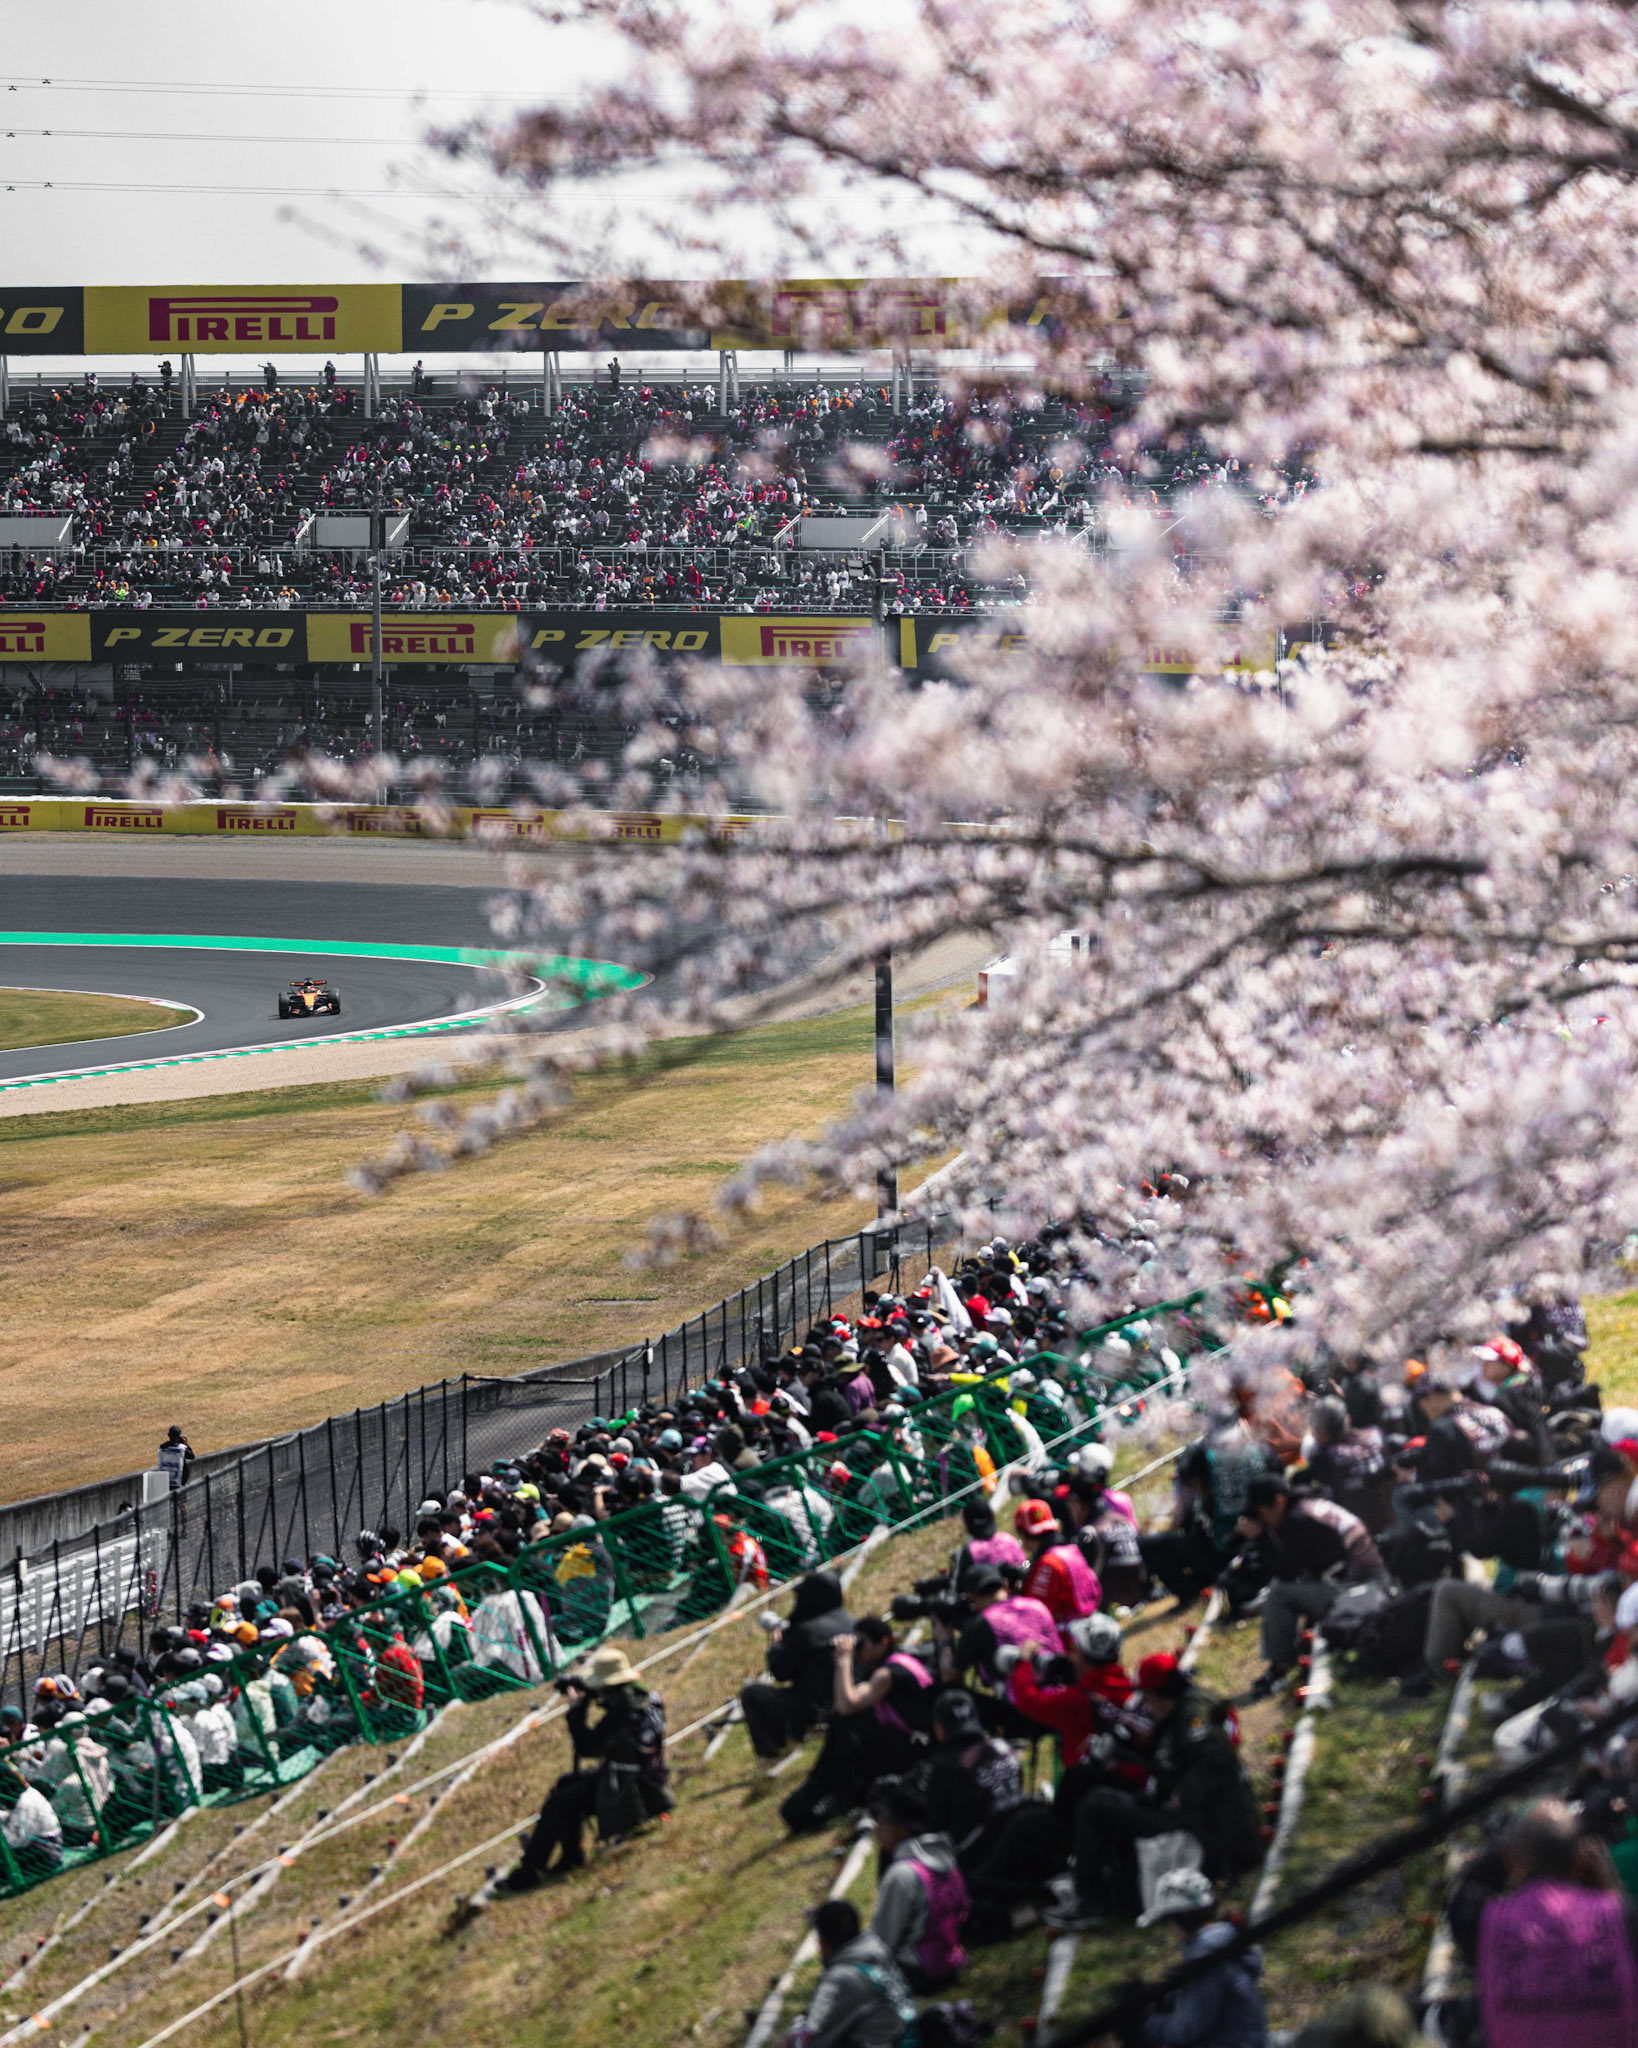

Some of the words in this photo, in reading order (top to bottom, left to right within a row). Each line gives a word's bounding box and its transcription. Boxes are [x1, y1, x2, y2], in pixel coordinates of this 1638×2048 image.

[0, 307, 64, 334] O
[148, 296, 338, 341] PIRELLI
[421, 303, 475, 331] P
[0, 622, 46, 652] LLI
[104, 628, 142, 647] P
[151, 628, 294, 647] ZERO
[532, 630, 565, 649] P
[575, 630, 709, 650] ZERO
[760, 626, 872, 657] PIREL
[928, 633, 959, 653] P
[0, 806, 31, 826] LLI
[85, 807, 163, 828] PIRELLI
[217, 809, 296, 830] PIRELLI
[347, 811, 421, 832] PIRELLI
[472, 813, 544, 835] PELLI
